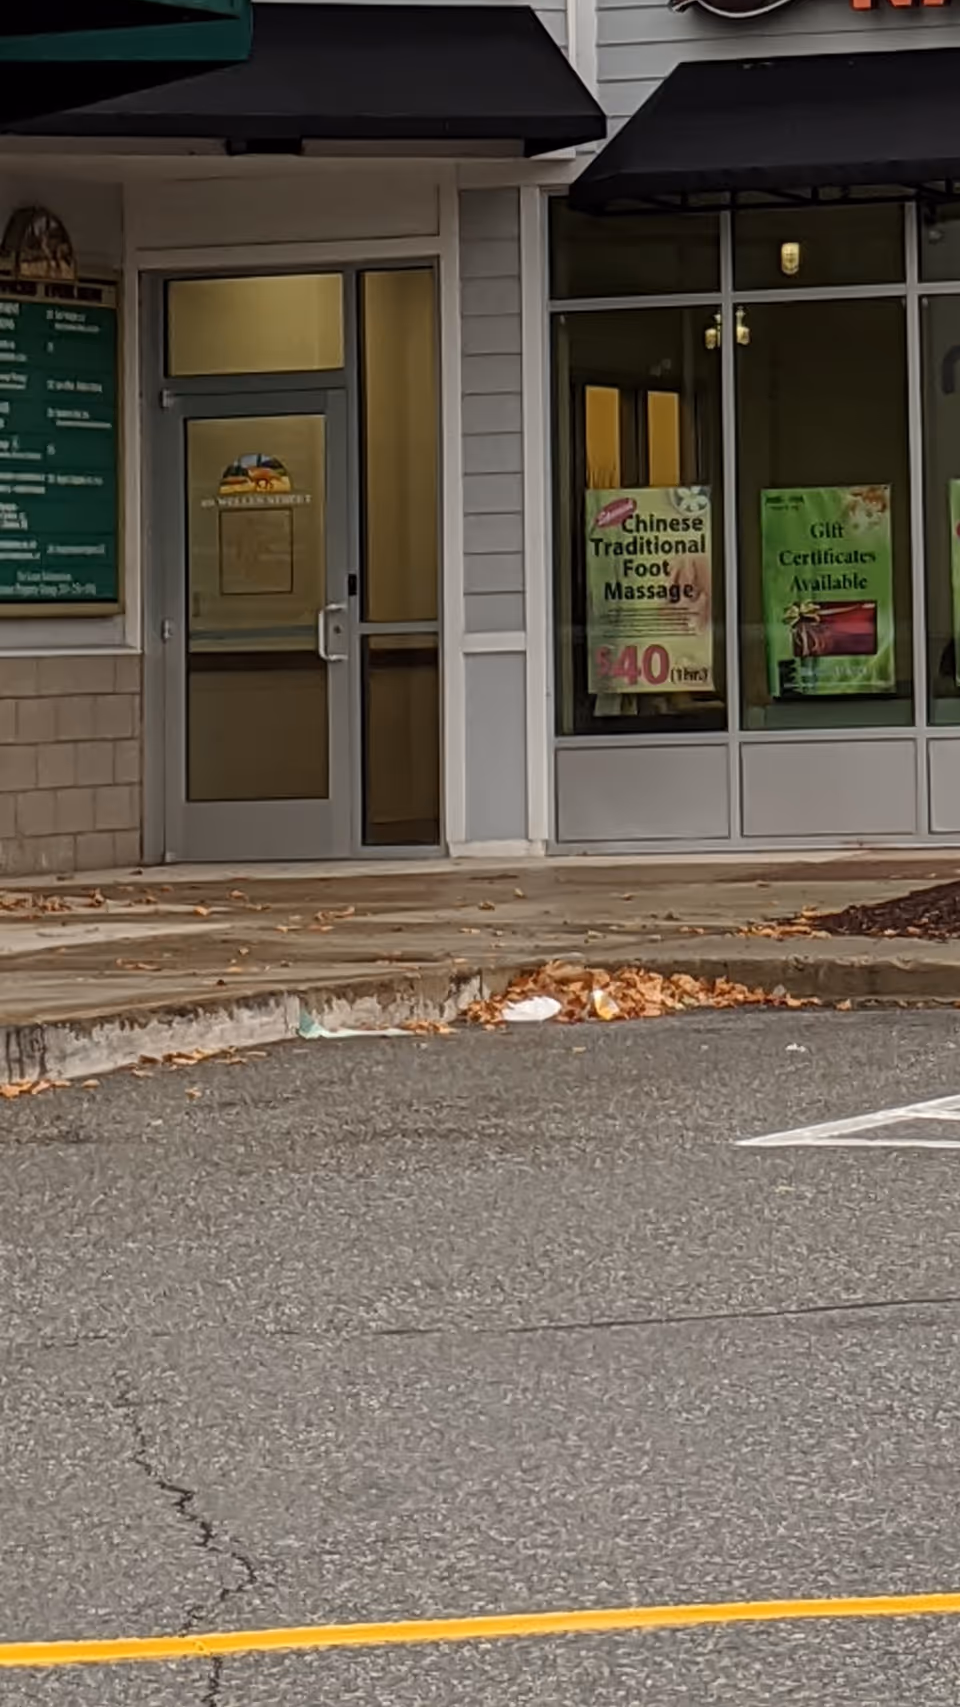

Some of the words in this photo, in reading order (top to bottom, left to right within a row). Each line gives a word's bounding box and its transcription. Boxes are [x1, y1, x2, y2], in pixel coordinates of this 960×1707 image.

[621, 514, 704, 533] Chinese
[810, 521, 844, 539] Gift
[590, 533, 706, 556] Traditional
[778, 549, 876, 567] Certificates
[622, 559, 671, 578] Foot
[604, 581, 694, 603] Massage
[789, 573, 868, 592] Available
[595, 644, 671, 685] $40
